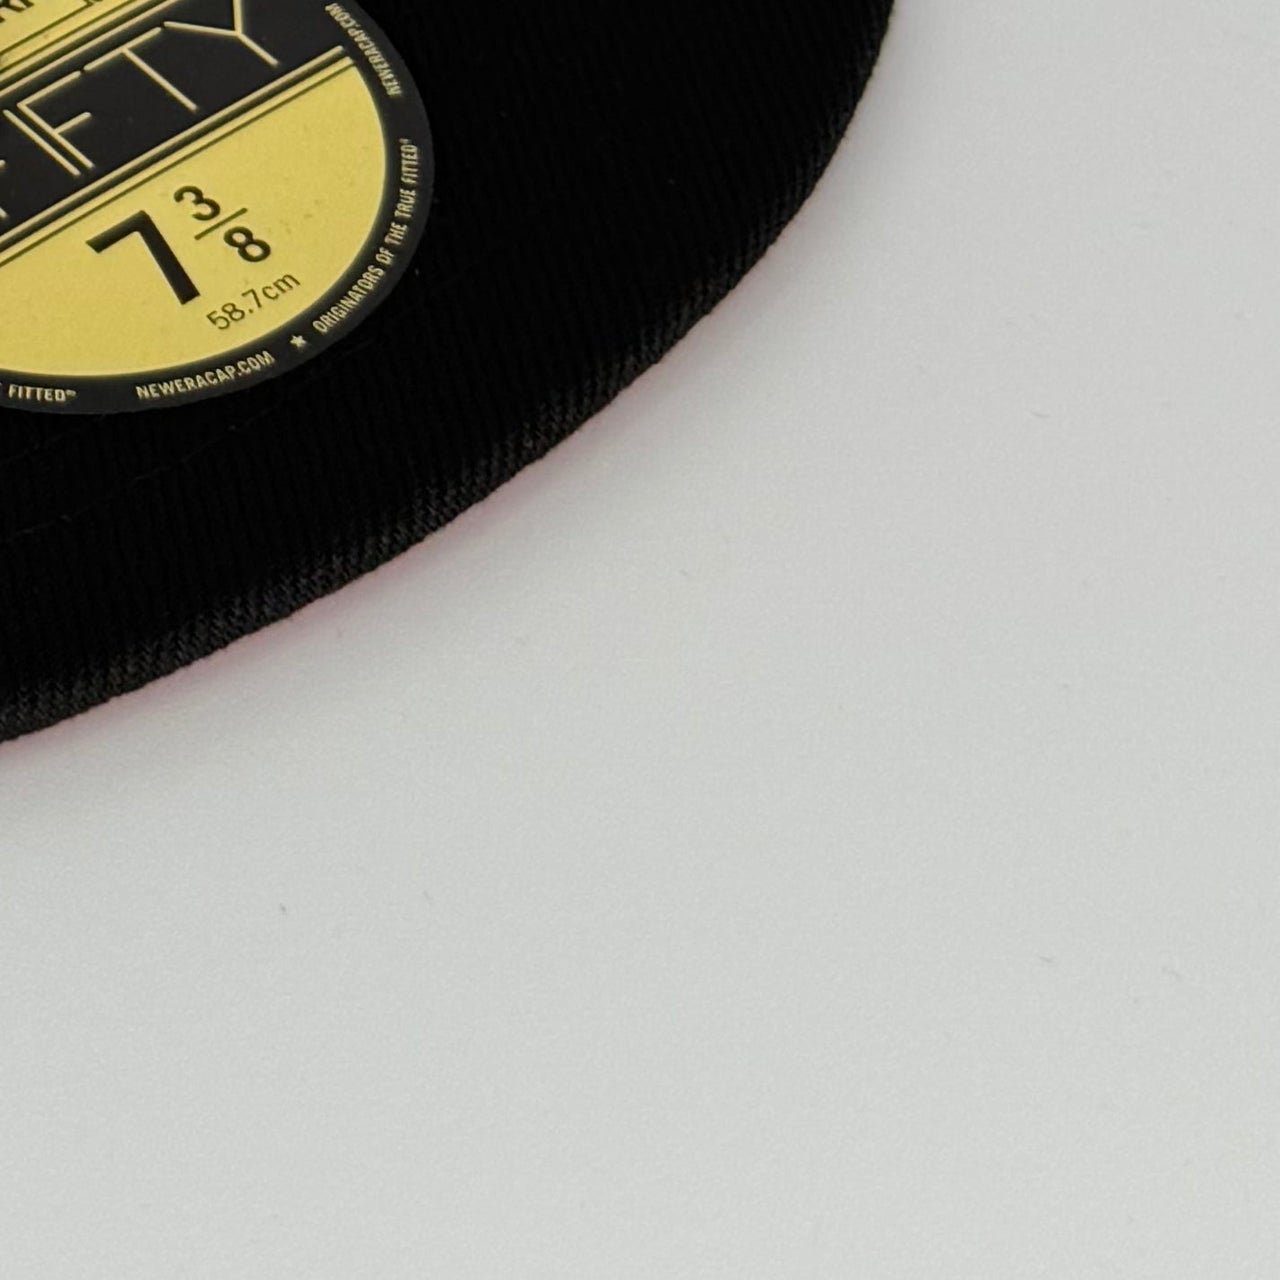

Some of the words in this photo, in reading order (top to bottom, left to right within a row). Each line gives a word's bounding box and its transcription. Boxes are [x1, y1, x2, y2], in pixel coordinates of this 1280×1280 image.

[394, 187, 417, 218] TRUE
[86, 209, 200, 306] 7
[375, 246, 396, 267] OF
[384, 221, 408, 246] THE
[205, 273, 301, 330] 58.7cm
[312, 264, 385, 334] ORIGINATORS
[135, 349, 276, 400] NEWERACAP.COM
